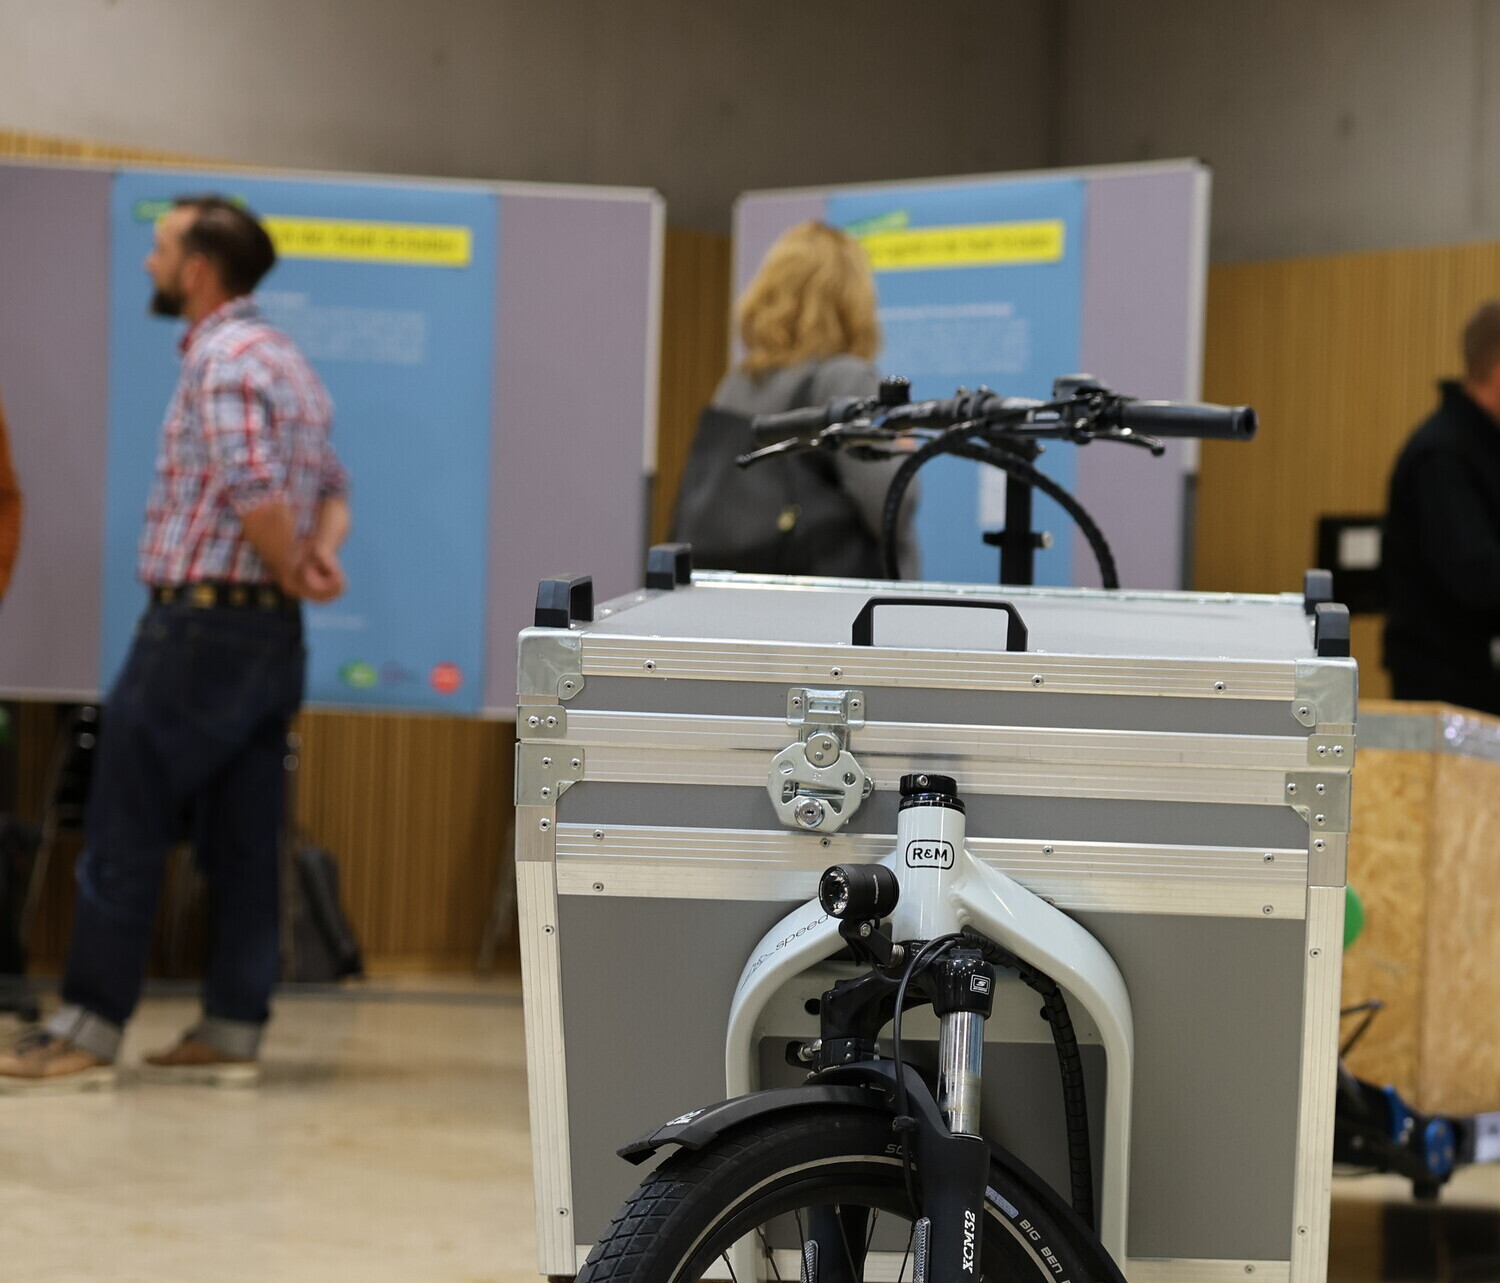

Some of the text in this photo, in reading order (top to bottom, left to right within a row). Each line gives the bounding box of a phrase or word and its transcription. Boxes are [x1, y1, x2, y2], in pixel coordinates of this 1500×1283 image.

[912, 847, 948, 862] R&M
[962, 1209, 976, 1274] XCM32
[1019, 1218, 1064, 1274] BIG BEN
